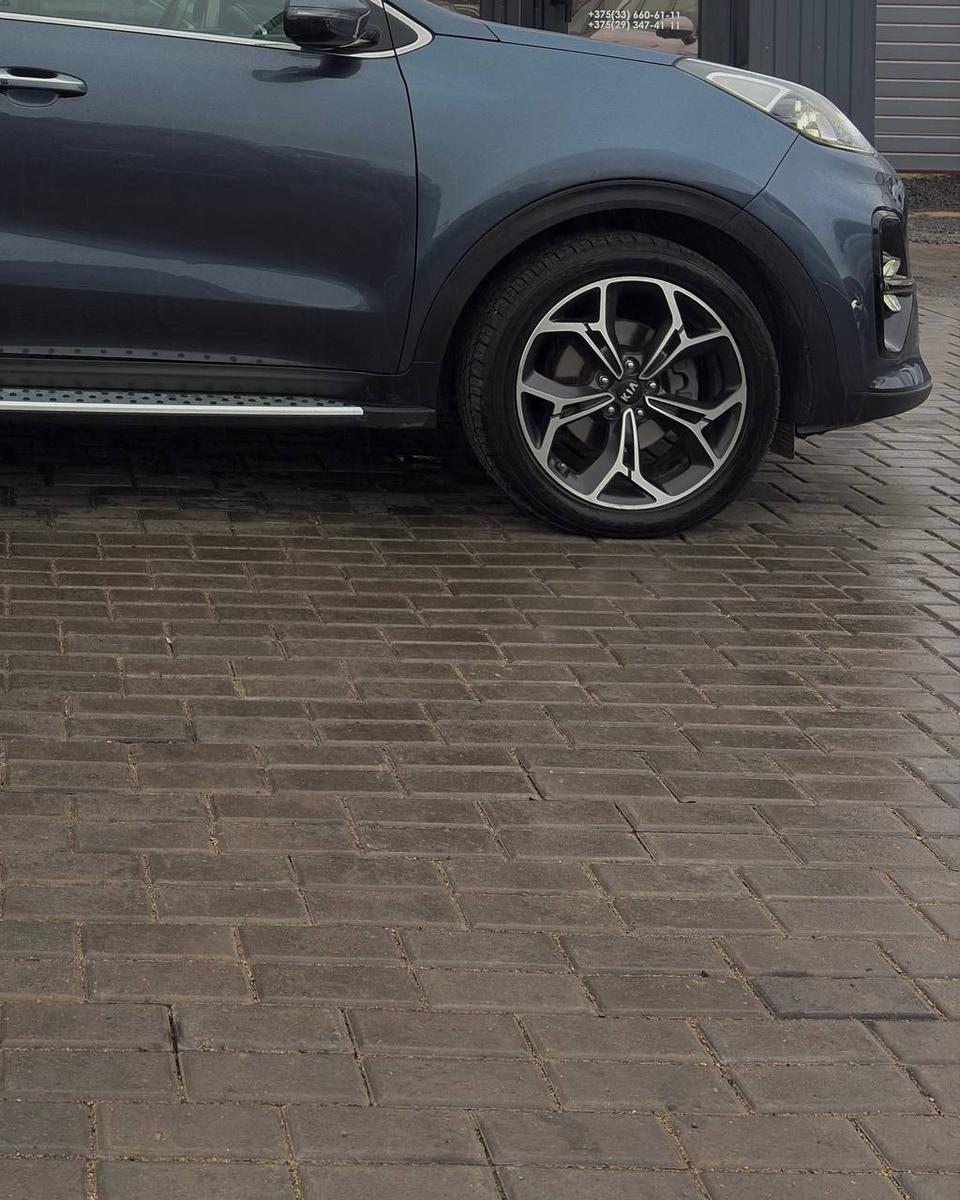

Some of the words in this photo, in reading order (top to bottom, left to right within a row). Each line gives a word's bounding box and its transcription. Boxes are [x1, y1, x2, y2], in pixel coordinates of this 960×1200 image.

[588, 10, 630, 20] +375(33)
[632, 10, 680, 20] 660-61-11
[588, 20, 630, 30] +375(29)
[632, 20, 680, 30] 347-4111
[620, 382, 639, 402] KIA
